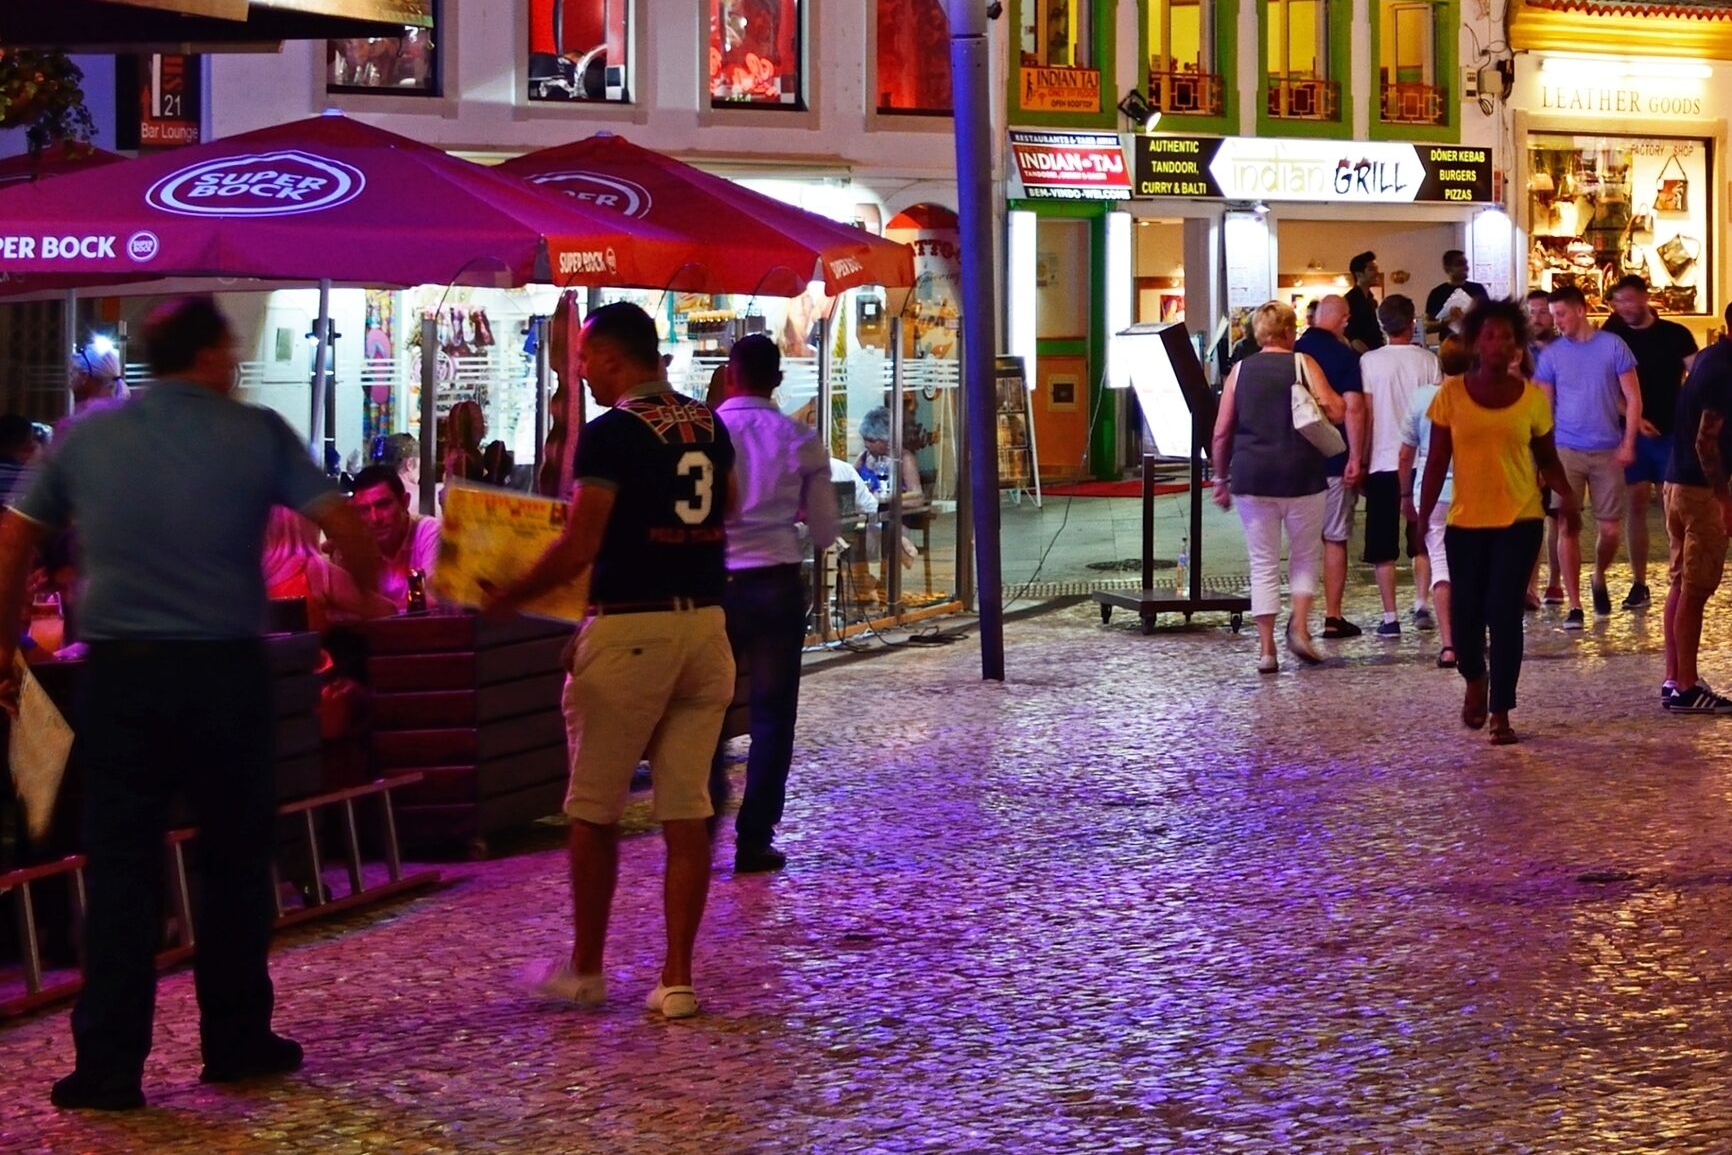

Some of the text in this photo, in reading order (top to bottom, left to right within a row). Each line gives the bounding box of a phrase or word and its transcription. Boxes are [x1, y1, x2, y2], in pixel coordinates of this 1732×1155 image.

[1037, 70, 1098, 88] INDIAN TAJ
[164, 94, 181, 116] 21
[1542, 85, 1701, 115] LEATHER GOODS
[141, 122, 199, 143] Bar Lounge
[1149, 140, 1199, 154] AUTHENTIC
[1430, 148, 1485, 163] DÖNER KEBAB
[1630, 144, 1694, 157] FACTORY SHOP
[1019, 152, 1123, 174] INDIAN TAJ
[1151, 160, 1199, 176] TANDOORI,
[1232, 141, 1408, 195] indian GRILL
[194, 170, 328, 192] SUPER
[1439, 169, 1477, 182] BURGERS
[187, 183, 313, 201] BOCK
[1142, 181, 1206, 195] CURRY & BALTI
[1445, 188, 1472, 201] PIZZAS
[41, 236, 116, 258] BOCK
[559, 251, 582, 274] SUPER
[582, 251, 606, 273] BOCK
[674, 450, 714, 525] 3
